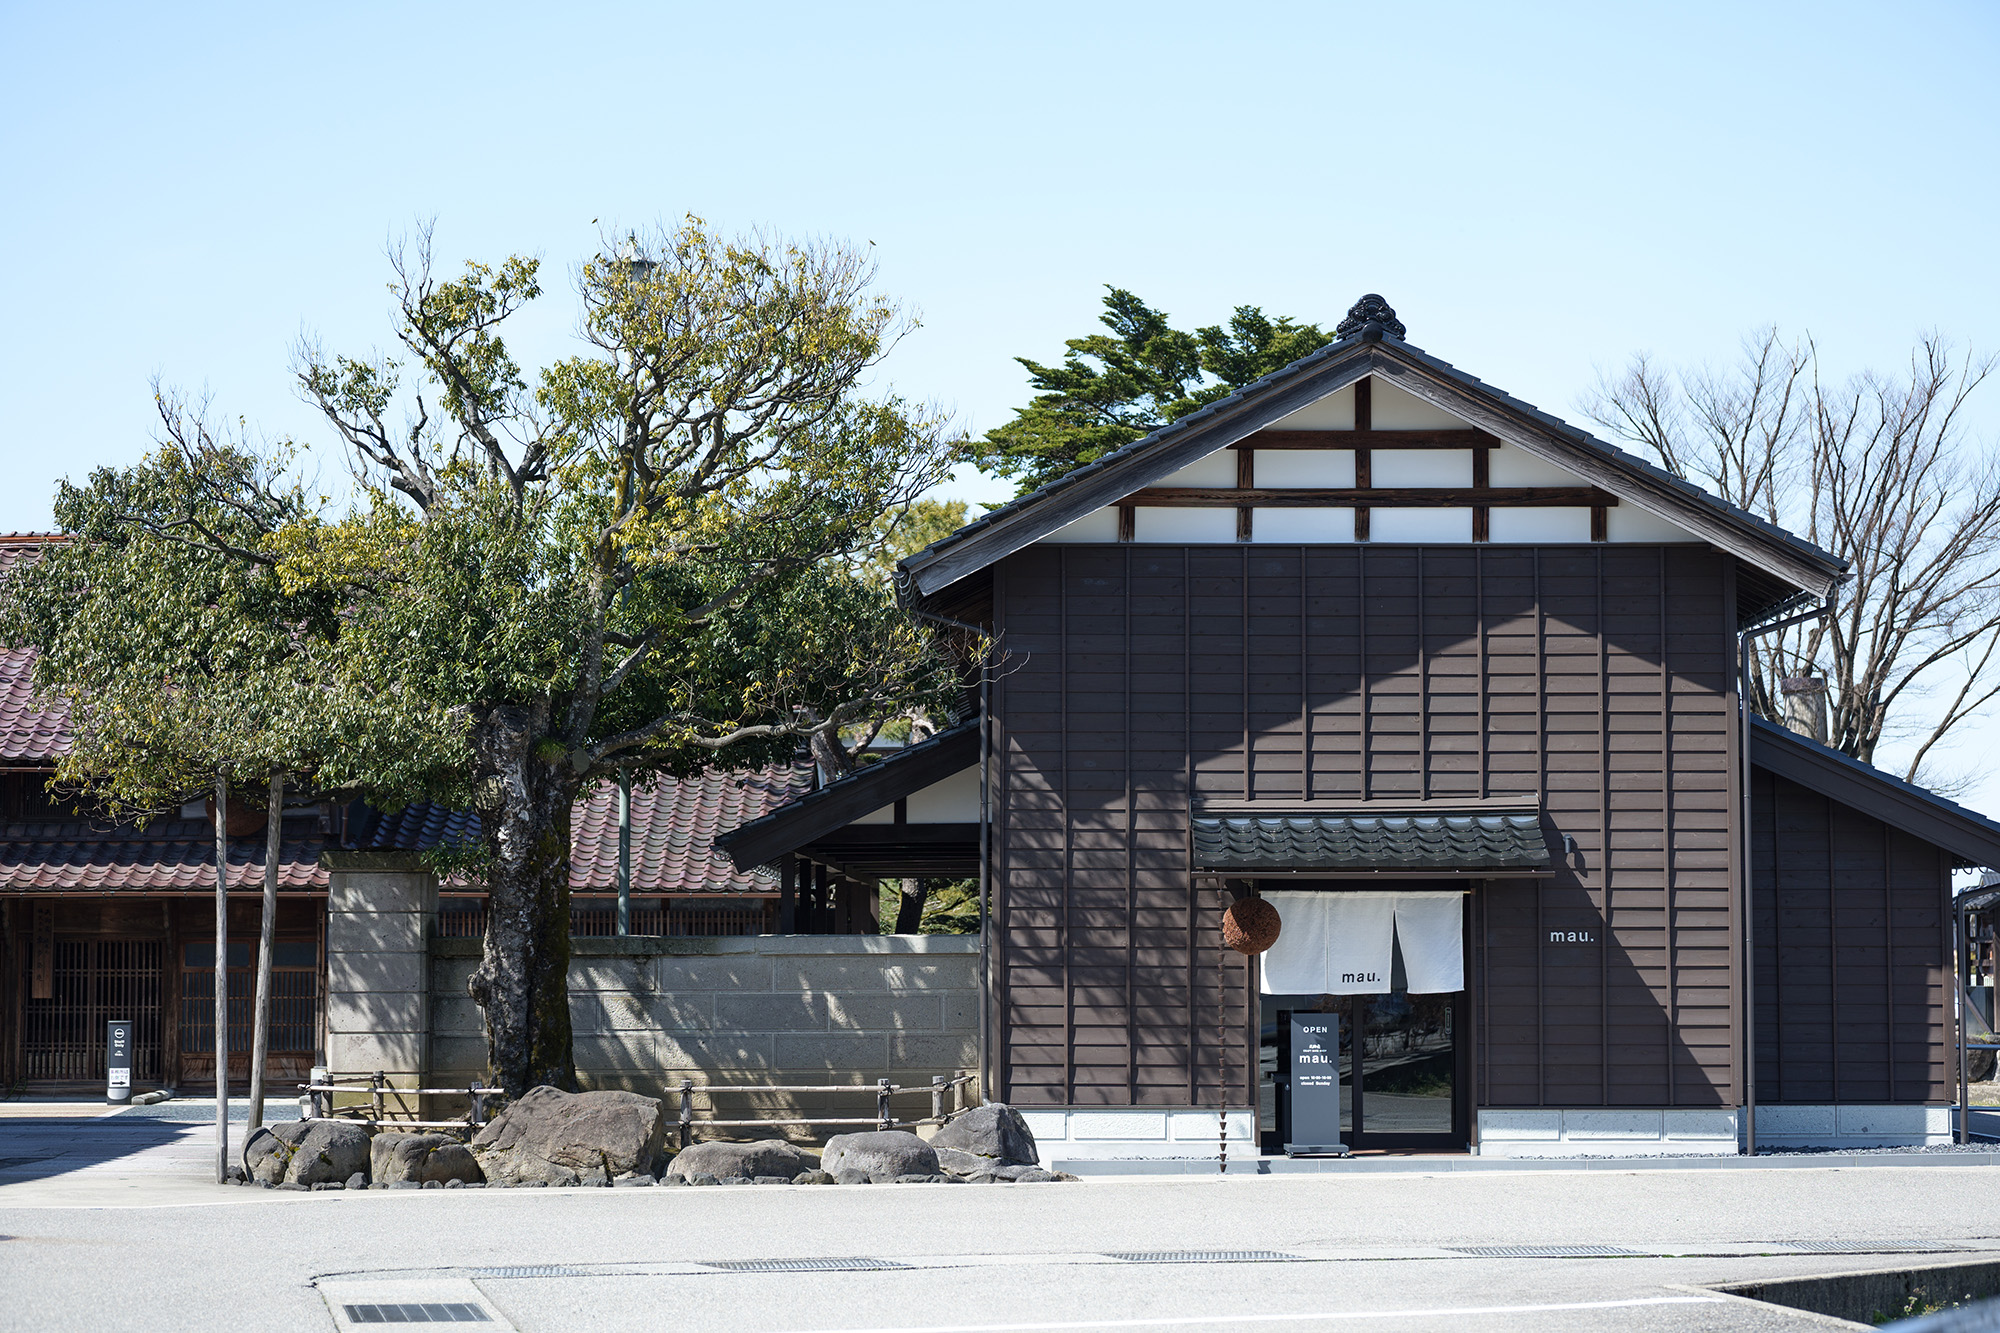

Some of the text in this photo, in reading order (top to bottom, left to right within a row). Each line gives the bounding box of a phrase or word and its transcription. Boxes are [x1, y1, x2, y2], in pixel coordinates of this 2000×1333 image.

[1550, 931, 1595, 942] mau.
[1342, 972, 1381, 983] mau.
[1302, 1026, 1328, 1034] OPEN
[1299, 1054, 1333, 1064] mau.
